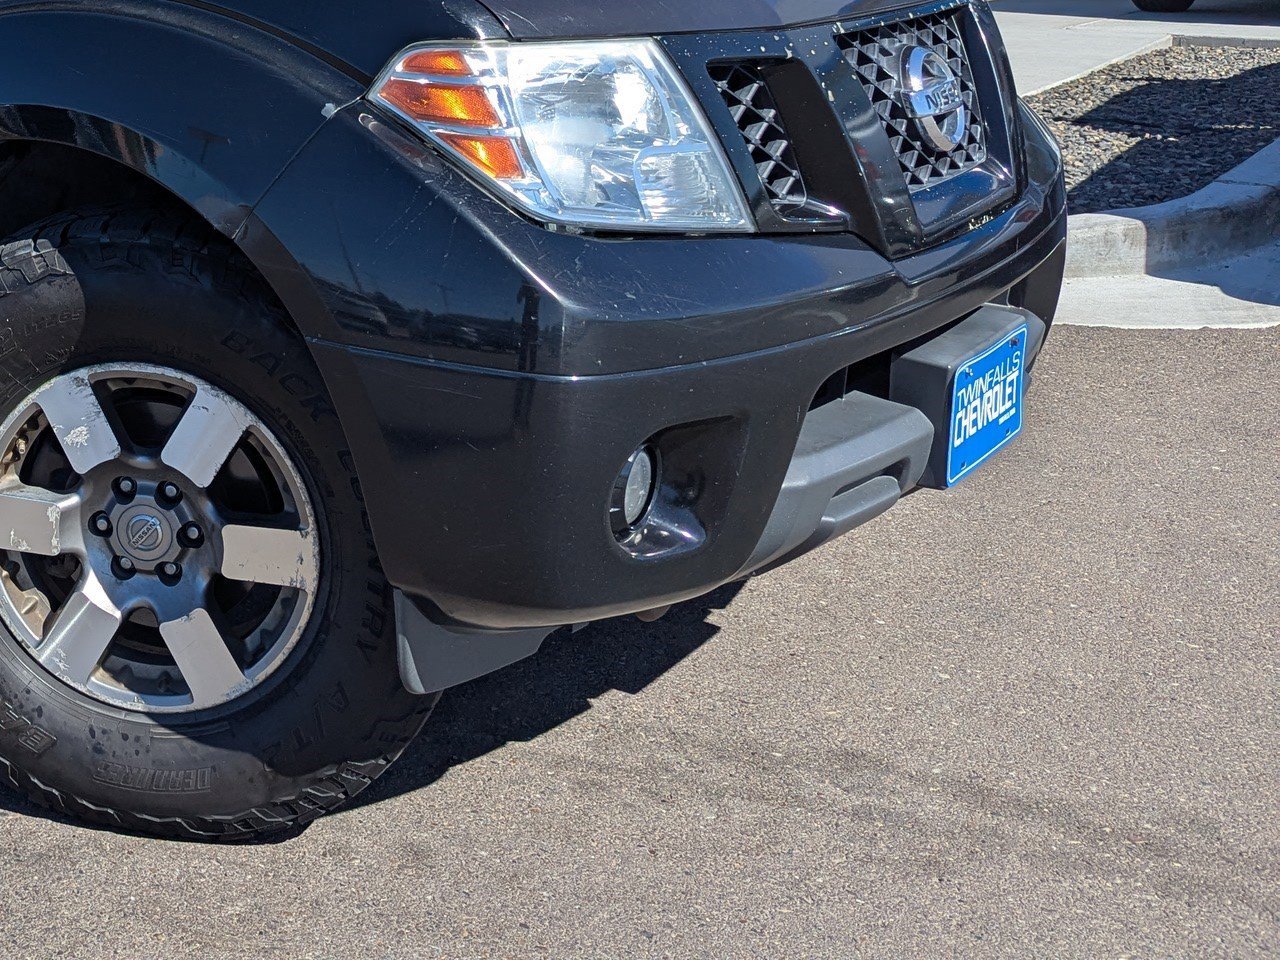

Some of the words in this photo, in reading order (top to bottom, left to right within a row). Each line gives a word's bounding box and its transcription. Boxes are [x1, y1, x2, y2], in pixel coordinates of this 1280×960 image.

[953, 369, 1020, 448] CHEVROLET
[957, 350, 1021, 412] TWINFALLS
[131, 521, 157, 546] NISSAN
